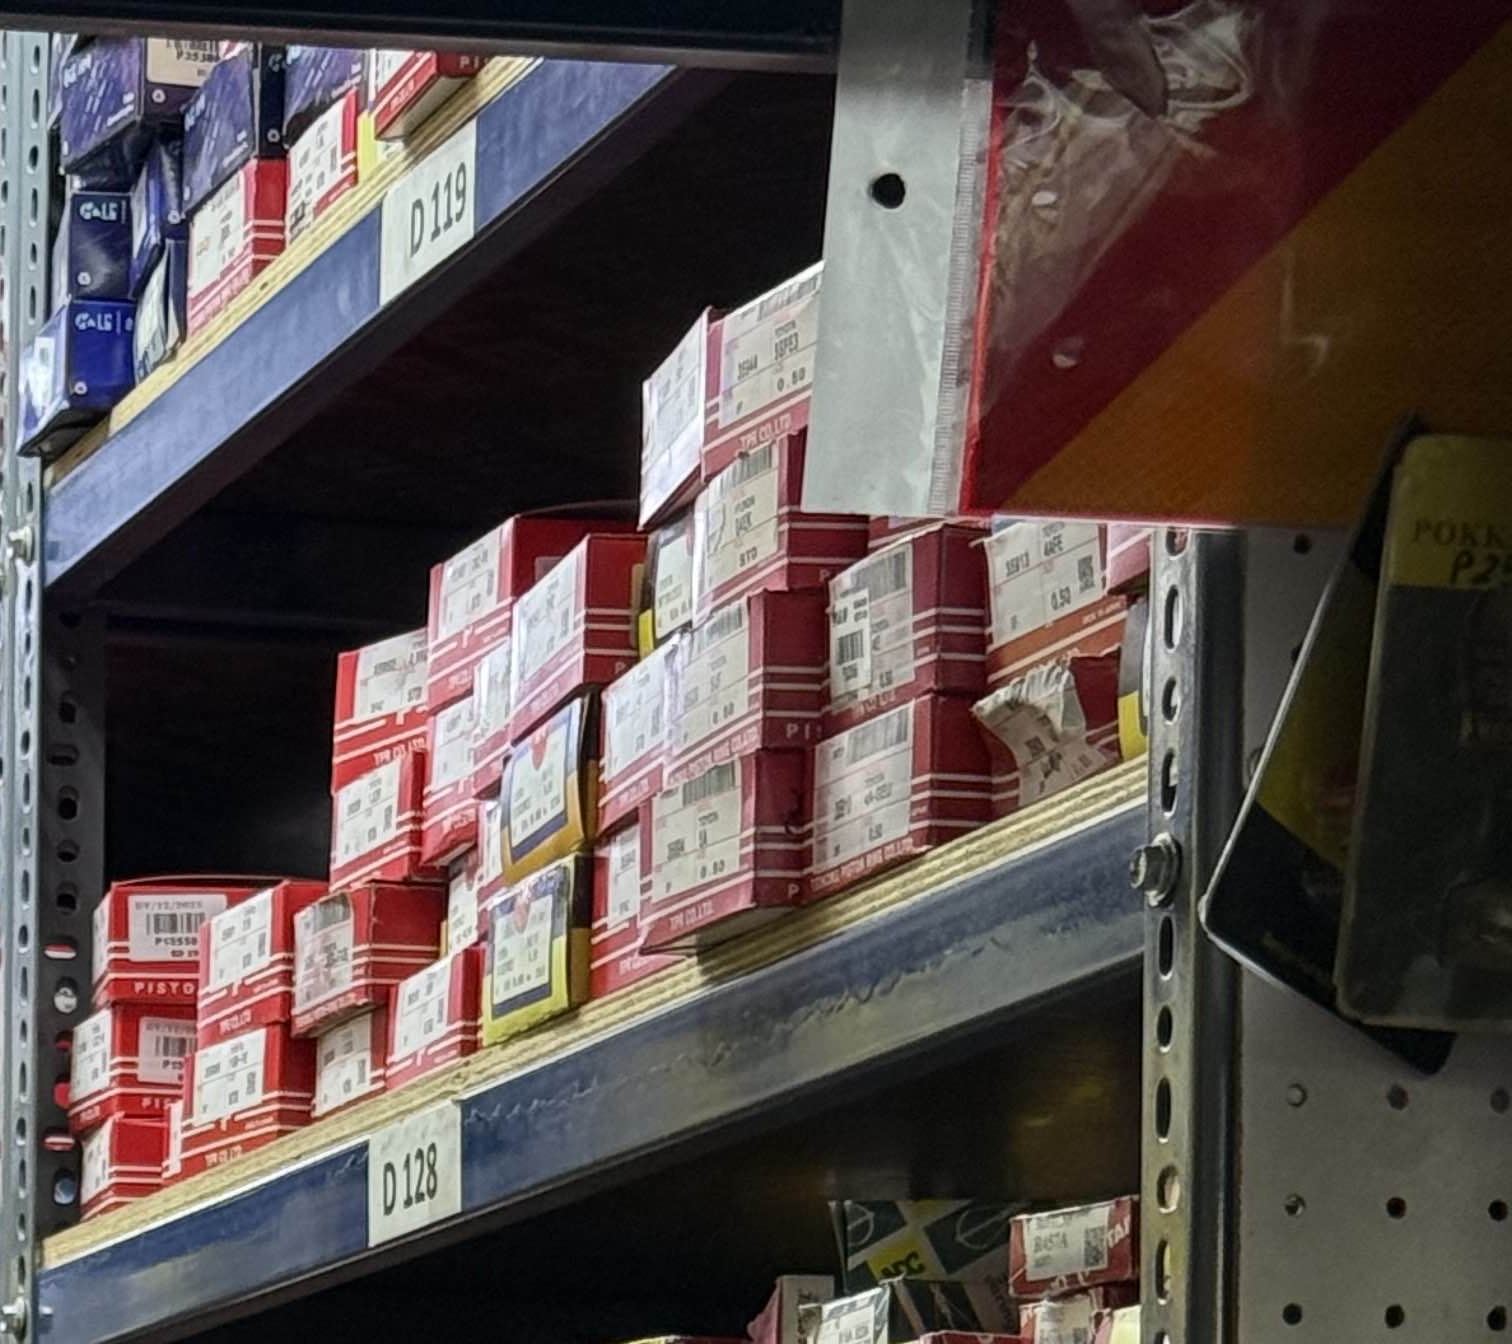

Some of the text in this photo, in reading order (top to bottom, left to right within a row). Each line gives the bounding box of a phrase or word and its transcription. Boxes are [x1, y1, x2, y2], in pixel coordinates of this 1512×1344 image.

[410, 161, 468, 259] D 119
[133, 980, 197, 996] PISTO
[381, 1141, 439, 1218] D 128
